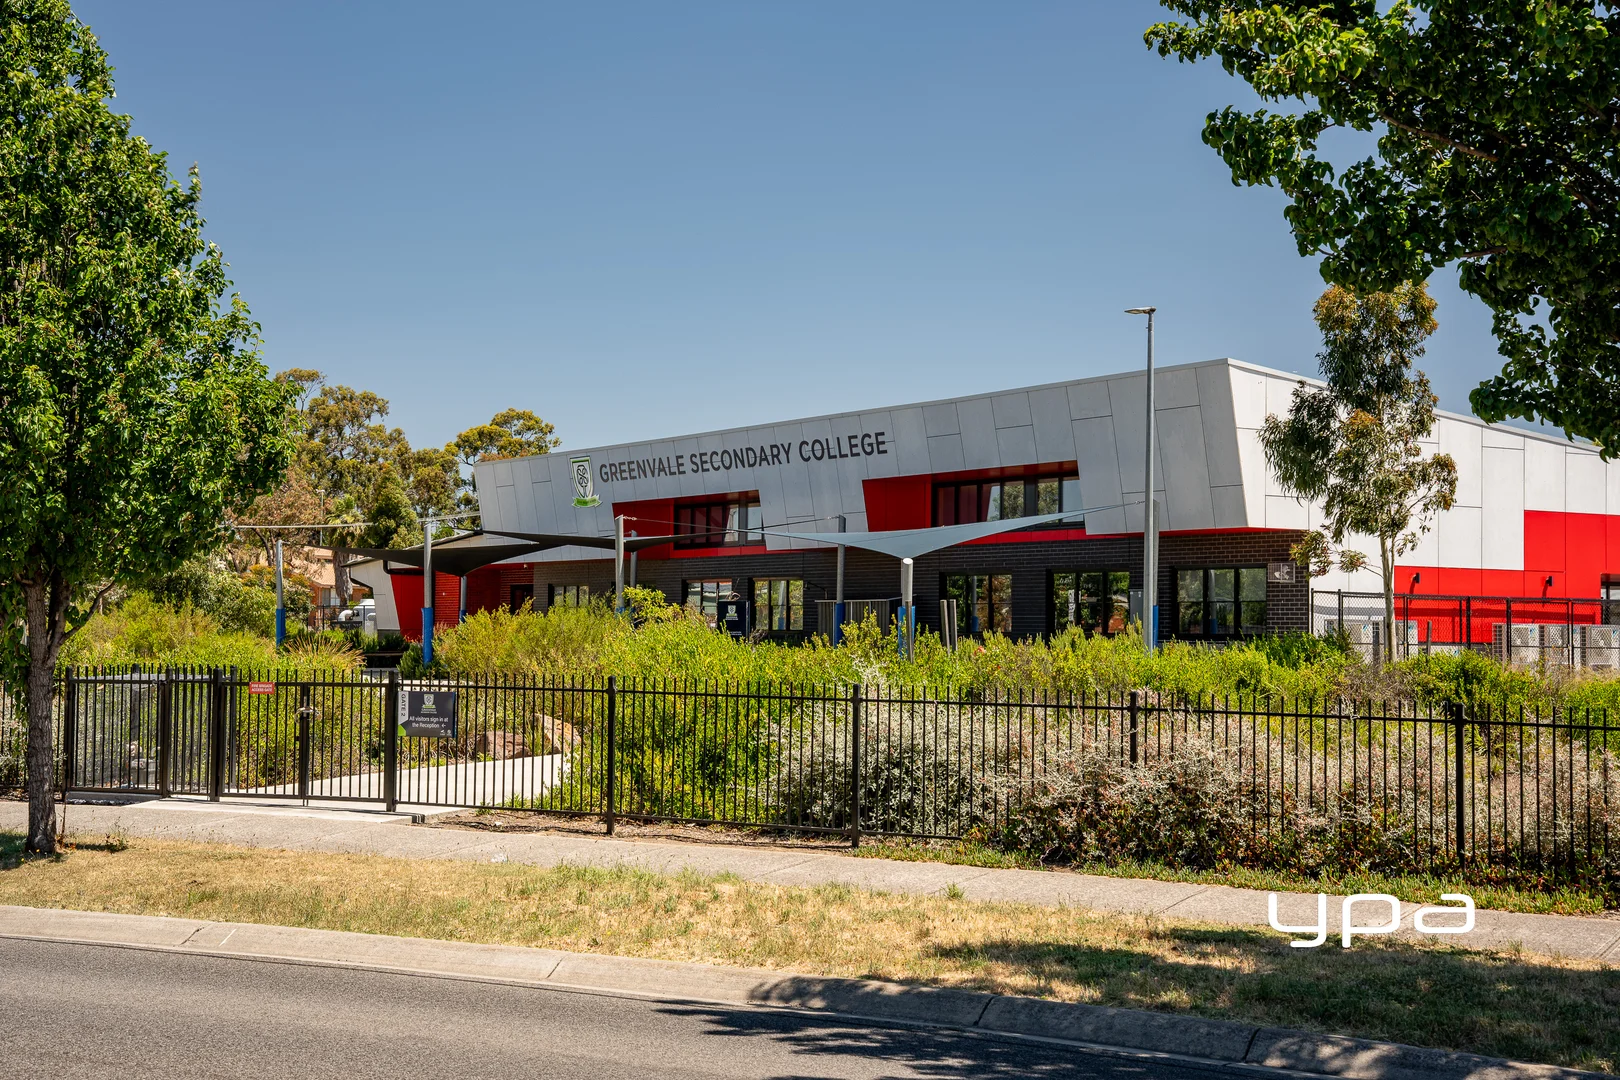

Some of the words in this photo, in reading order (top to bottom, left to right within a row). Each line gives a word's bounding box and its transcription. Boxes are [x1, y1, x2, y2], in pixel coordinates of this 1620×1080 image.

[600, 454, 686, 483] GREENVALE
[690, 442, 792, 474] SECONDARY
[799, 431, 888, 462] COLLEGE
